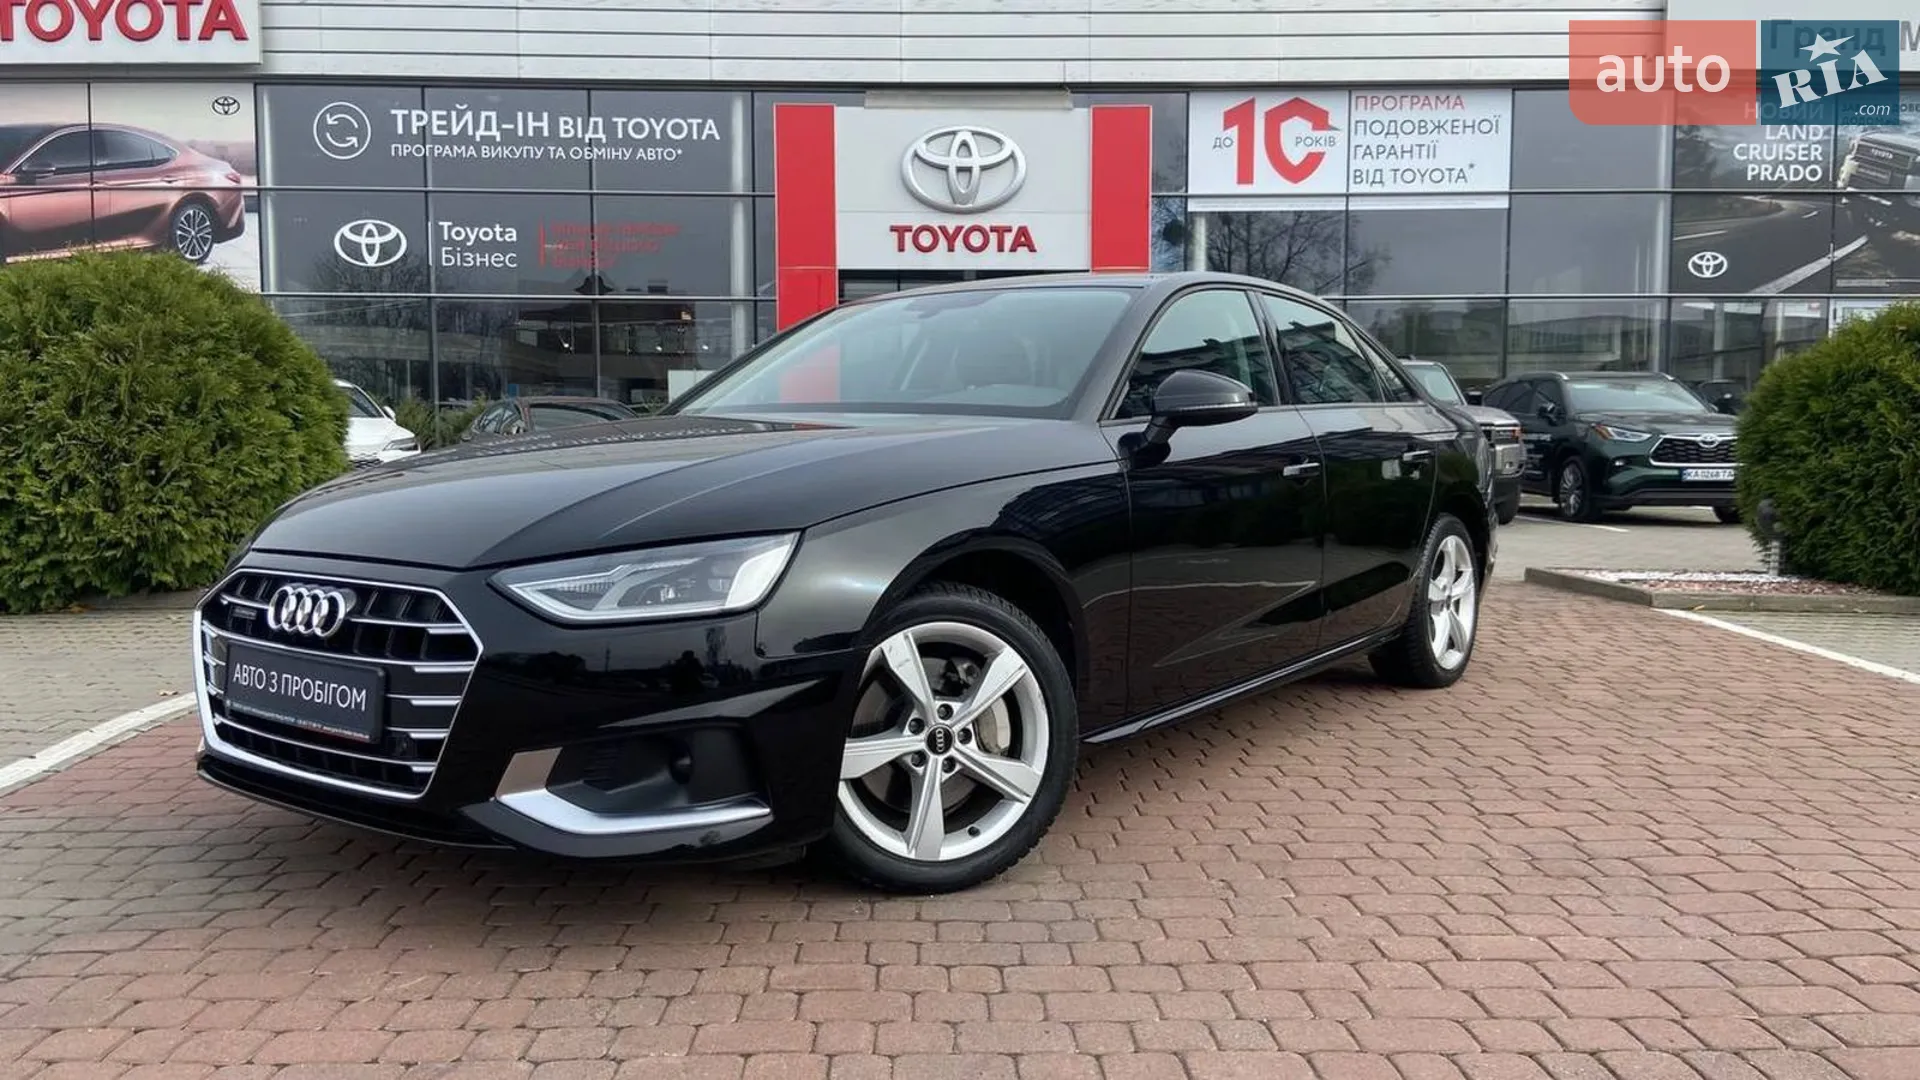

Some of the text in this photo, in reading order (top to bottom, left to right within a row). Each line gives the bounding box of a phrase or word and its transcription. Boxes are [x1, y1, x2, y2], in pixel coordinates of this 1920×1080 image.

[0, 0, 249, 41] TOYOTA
[1354, 95, 1466, 111] ПРОГРАМА
[390, 103, 721, 144] ТРЕЙД-ІН ВІД TOYOTA
[1354, 115, 1502, 138] ПОДОВЖЕНОЇ
[1765, 124, 1824, 140] LAND
[391, 144, 478, 159] ПРОГРАМА
[481, 146, 544, 160] ВИКУПУ
[548, 147, 567, 160] ТА
[569, 147, 632, 162] ОБМІНУ
[1213, 136, 1234, 149] ДО
[1295, 136, 1337, 148] РОКІВ
[1353, 140, 1439, 161] ГАРАНТІЇ
[1733, 143, 1823, 161] CRUISER
[1353, 168, 1385, 187] ВІД
[1746, 165, 1823, 181] PRADO
[439, 221, 518, 245] Toyota
[889, 225, 1037, 253] TOYOTA
[441, 246, 518, 268] Бізнес
[232, 663, 267, 690] АВТО
[281, 673, 366, 712] ПРОБІГОМ
